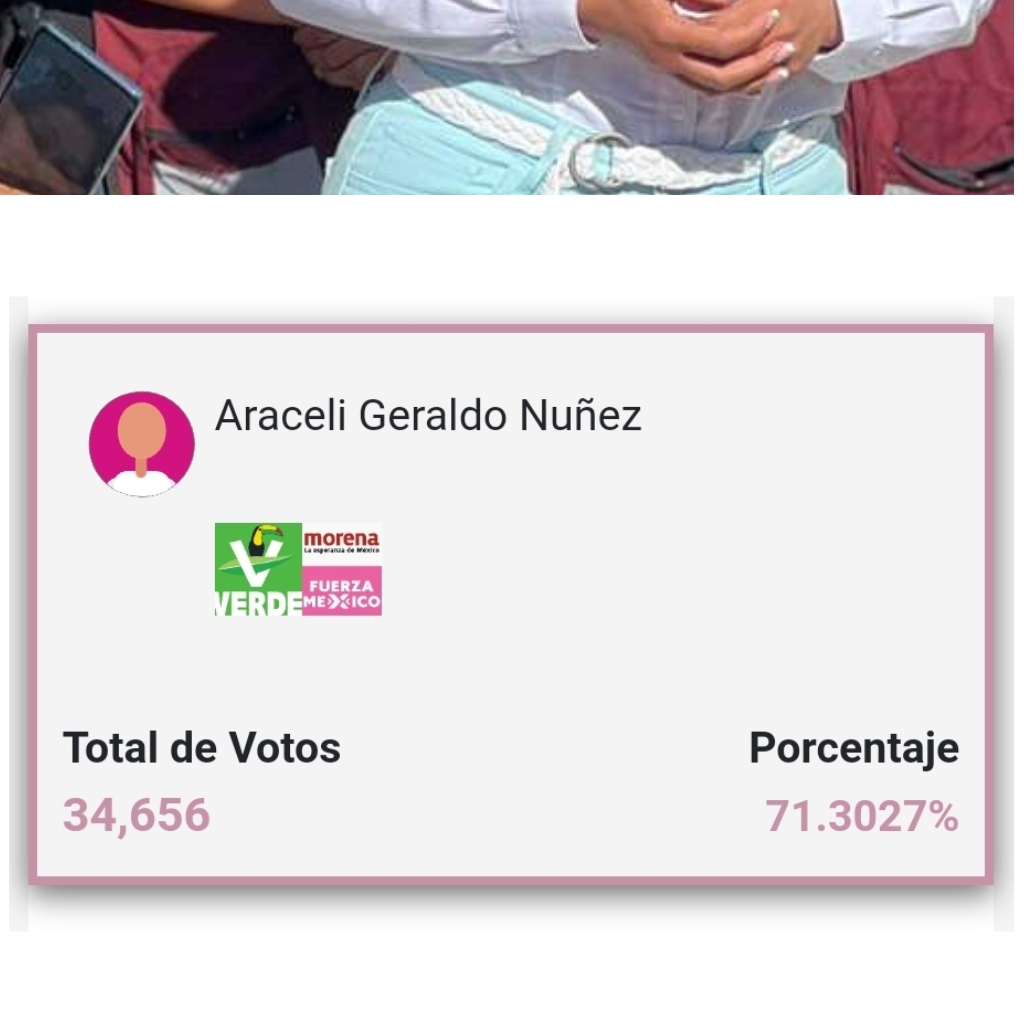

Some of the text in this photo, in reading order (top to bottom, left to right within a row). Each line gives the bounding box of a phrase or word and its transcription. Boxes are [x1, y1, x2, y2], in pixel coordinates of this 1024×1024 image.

[215, 397, 642, 431] Araceli Geraldo Nuñez
[304, 532, 380, 546] morena
[309, 580, 374, 592] FUERZA
[215, 591, 302, 616] VERDE
[62, 729, 340, 763] Total de Votos
[750, 729, 959, 772] Porcentaje
[64, 798, 210, 839] 34,656
[766, 799, 959, 832] 71.3027%
